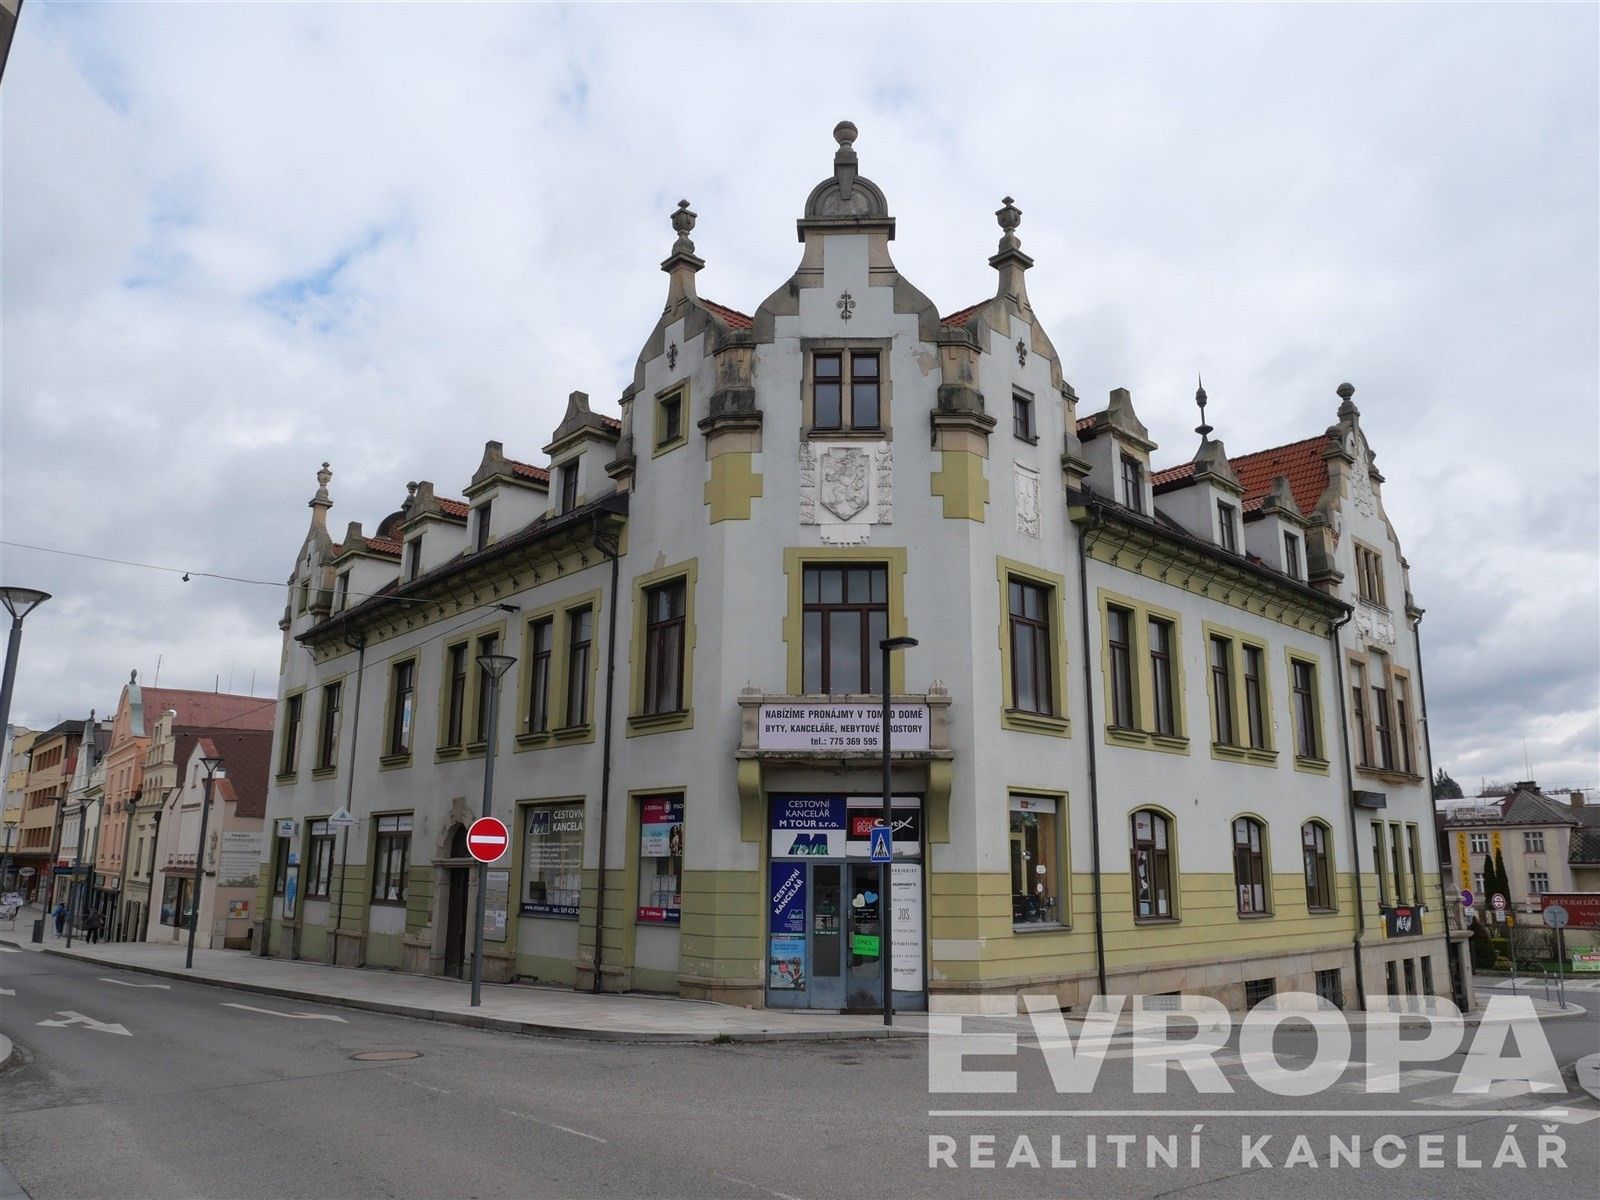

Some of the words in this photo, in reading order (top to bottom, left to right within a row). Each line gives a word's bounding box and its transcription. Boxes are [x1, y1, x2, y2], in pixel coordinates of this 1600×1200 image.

[765, 708, 805, 719] NABÍZÍME
[808, 708, 854, 719] PRONÁJMY
[857, 710, 863, 719] V
[867, 710, 895, 719] TOMO
[898, 708, 923, 719] DOMĚ
[765, 725, 788, 733] BYTY,
[790, 724, 837, 733] KANCELÁŘE,
[840, 723, 880, 733] NEBYTOVÉ
[890, 725, 922, 733] ROSTORY
[810, 737, 827, 745] tel.:
[829, 738, 844, 746] 775
[846, 738, 861, 746] 369
[863, 738, 878, 746] 595
[788, 798, 830, 808] CESTOVNÍ
[553, 809, 584, 819] CESTOVN
[785, 808, 830, 817] KANCELÁŘ
[552, 819, 584, 832] KANCELÁ
[773, 868, 801, 903] CESTOVNÍ
[774, 878, 804, 915] KANCELÁŘ
[1569, 897, 1600, 905] HAVLÍČK
